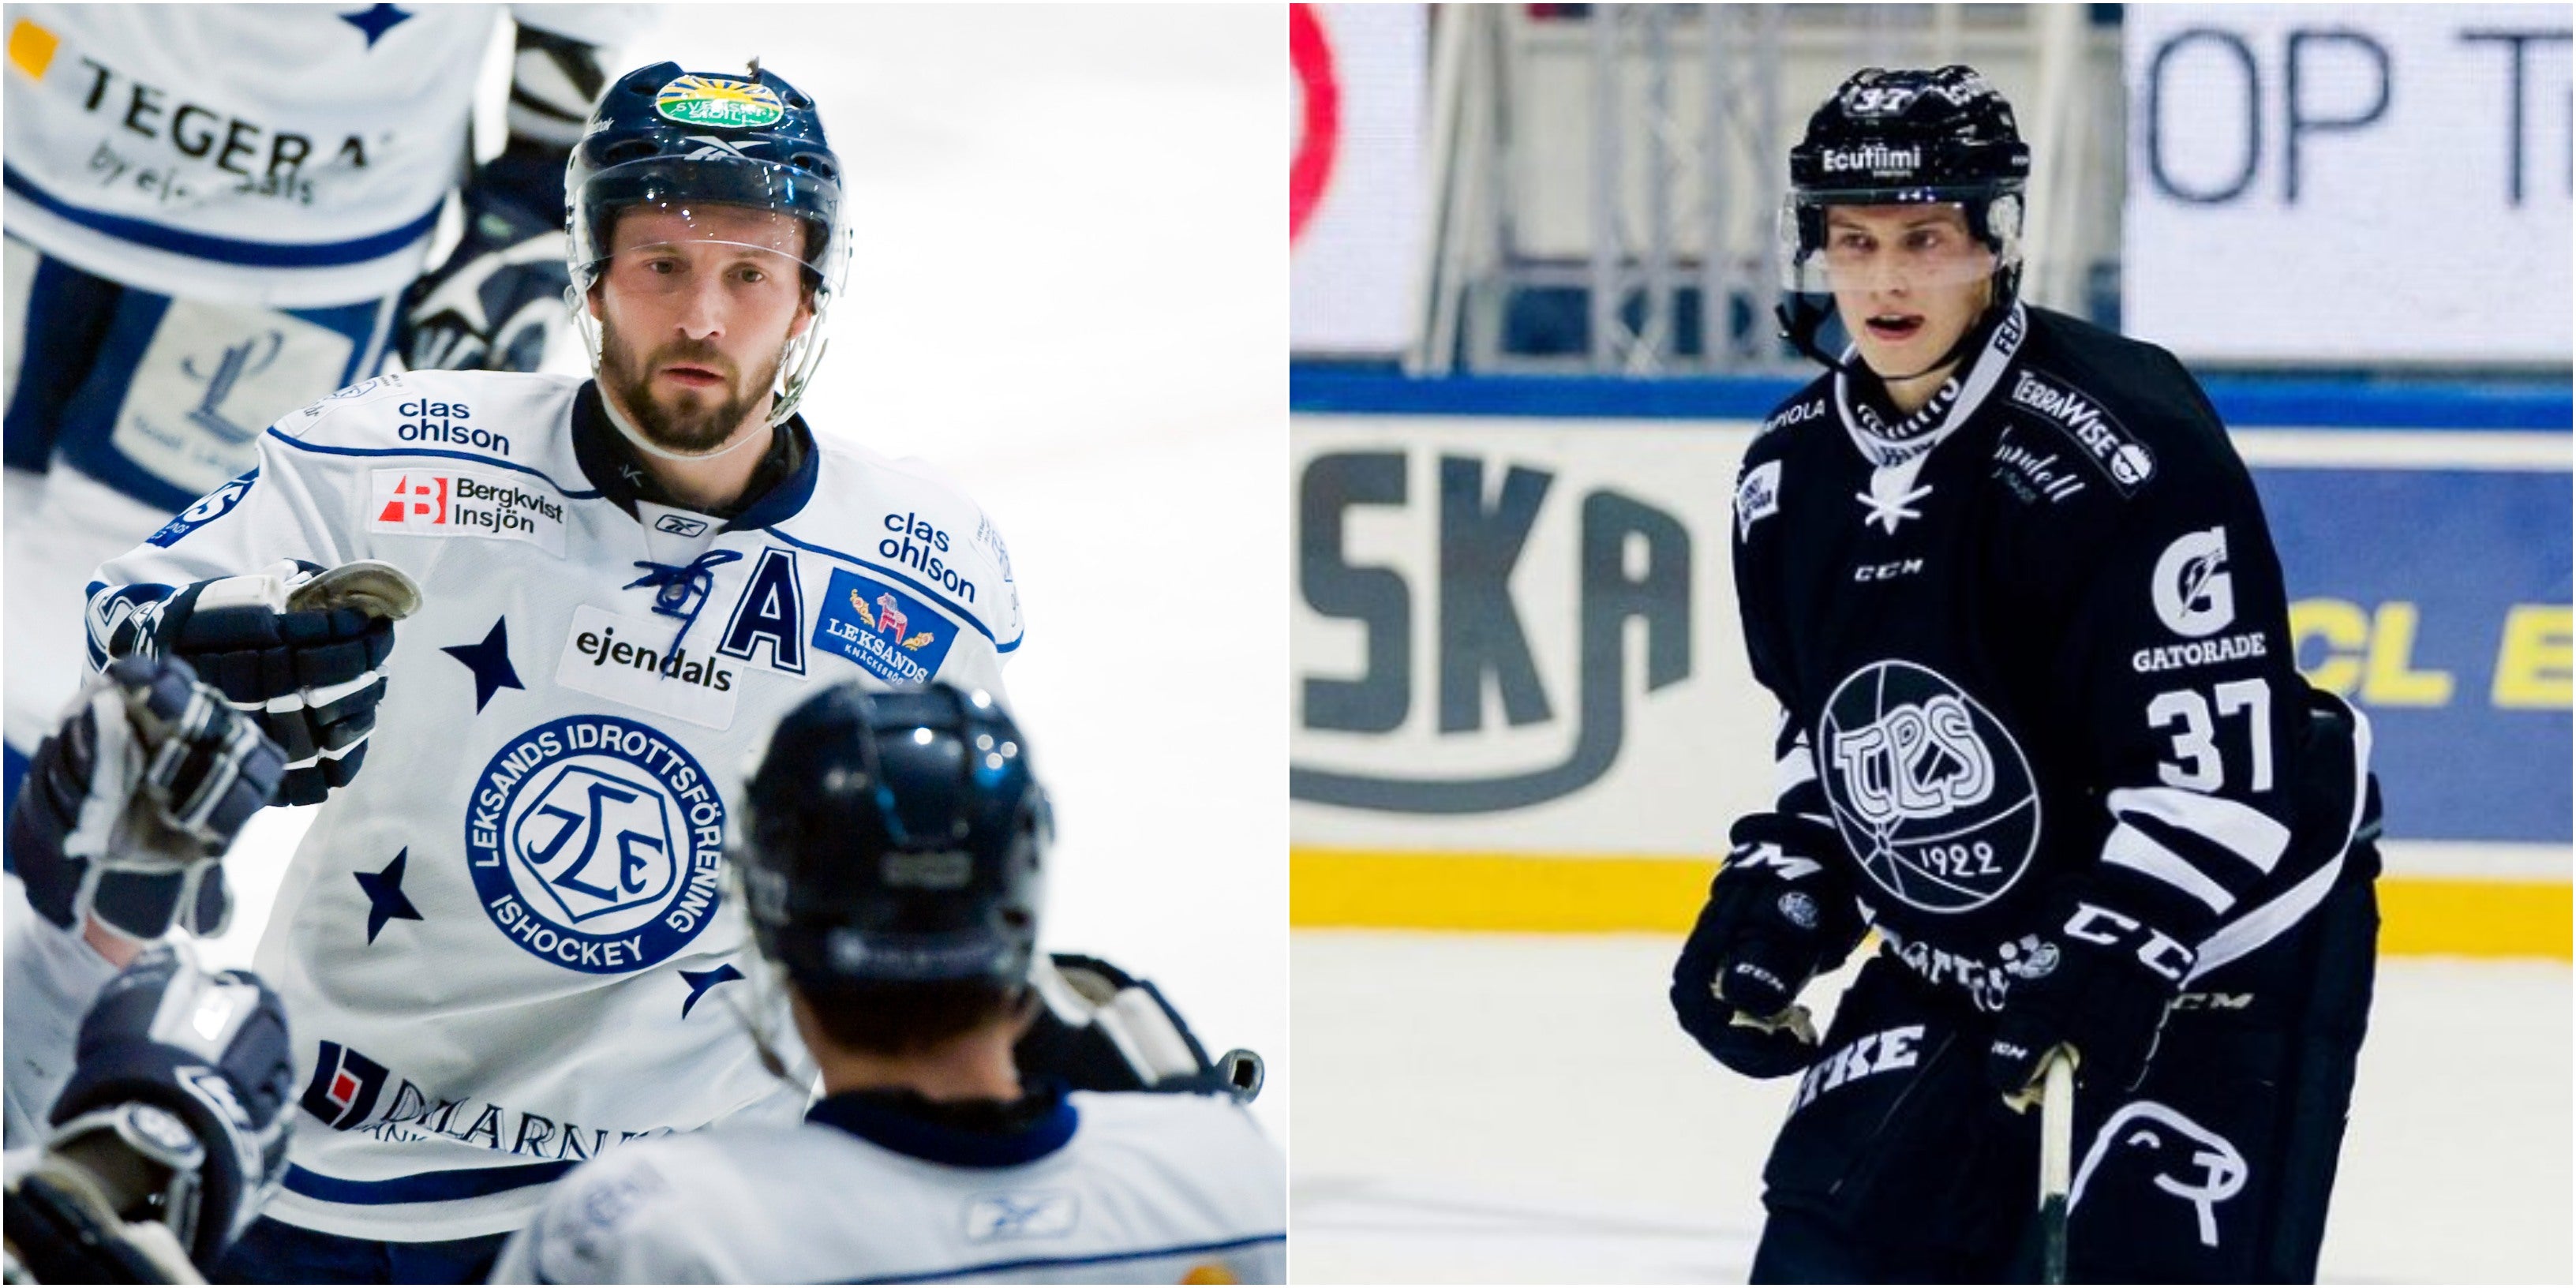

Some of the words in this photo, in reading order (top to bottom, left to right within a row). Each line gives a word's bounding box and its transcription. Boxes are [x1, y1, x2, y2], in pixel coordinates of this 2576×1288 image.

[2458, 28, 2573, 208] T
[398, 418, 510, 456] ohlson
[399, 398, 470, 419] clas
[455, 504, 535, 534] Insjön
[456, 477, 564, 524] Bergkvist
[884, 511, 950, 552] clas
[878, 537, 976, 604] ohlson
[1855, 557, 1924, 582] CCM
[717, 545, 806, 676] A
[575, 627, 733, 692] ejendals
[826, 617, 929, 684] LEKSANDS
[2132, 632, 2267, 672] GATORADE
[1833, 694, 1995, 824] TPS
[2146, 677, 2274, 794] 37
[472, 731, 563, 867] LEKSANDS
[565, 723, 722, 934] IDROTTSFÖRENING
[1919, 841, 2002, 877] 1922
[489, 893, 643, 968] ISHOCKEY
